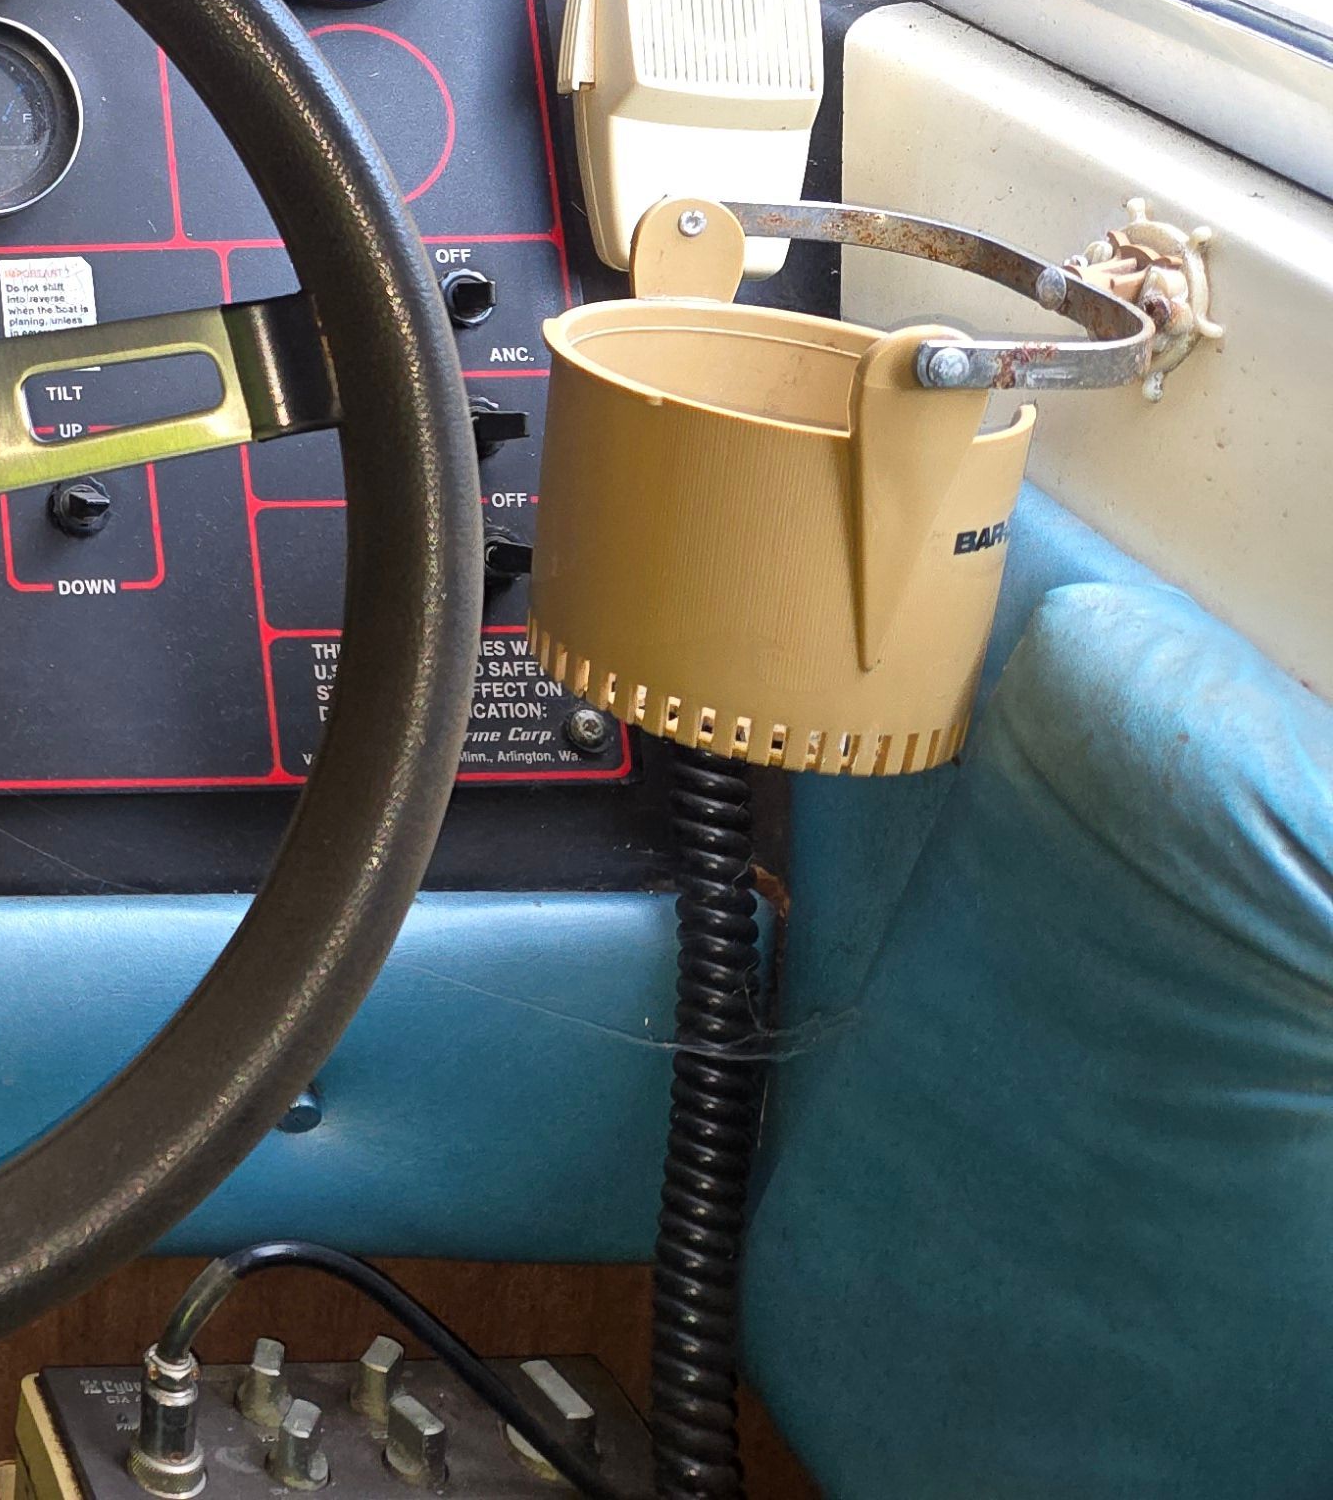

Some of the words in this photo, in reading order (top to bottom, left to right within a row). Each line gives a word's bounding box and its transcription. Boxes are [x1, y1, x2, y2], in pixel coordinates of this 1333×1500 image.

[22, 113, 33, 123] F
[435, 248, 472, 264] OFF
[6, 284, 20, 293] Do
[23, 283, 39, 293] not
[43, 282, 65, 293] shift
[7, 295, 25, 304] into
[29, 295, 65, 304] reverse
[8, 306, 34, 316] when
[37, 305, 53, 315] the
[80, 304, 89, 313] is
[50, 316, 83, 325] unless
[489, 346, 536, 363] ANC.
[45, 385, 83, 402] TILT
[59, 422, 83, 439] UP
[491, 492, 528, 509] OFF
[58, 579, 117, 596] DOWN
[488, 661, 546, 678] SAFET
[473, 681, 528, 698] FFECT
[534, 681, 563, 697] ON
[465, 730, 501, 742] rine
[508, 726, 556, 745] Corp.
[497, 750, 555, 765] Arlington,
[557, 750, 582, 762] Wa.
